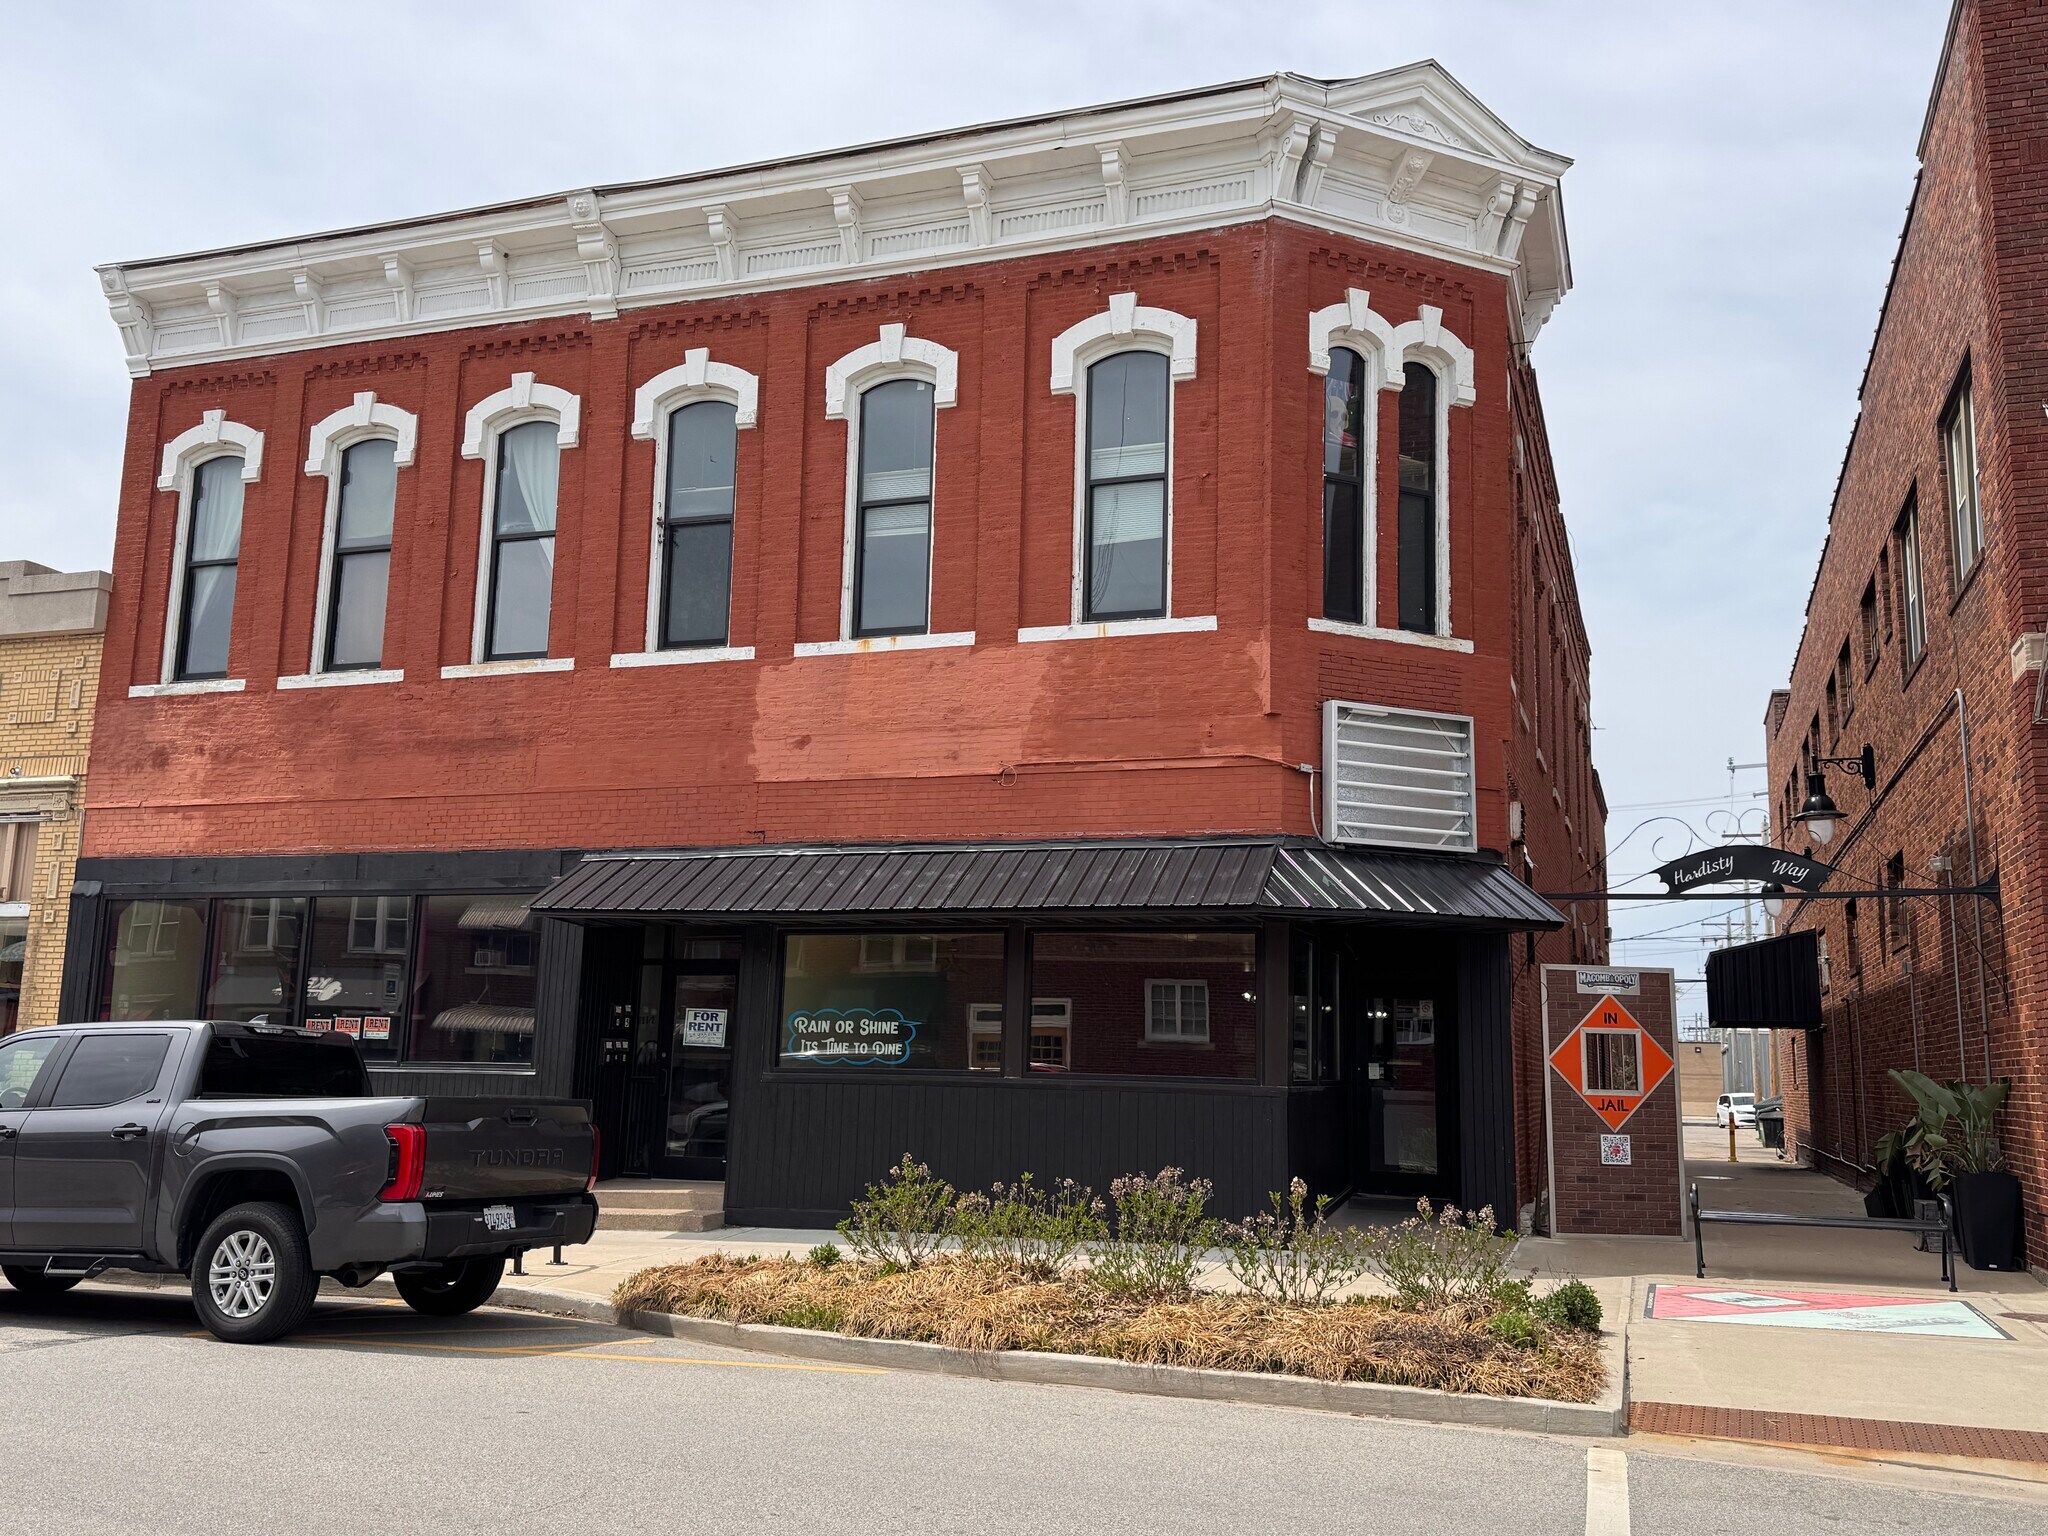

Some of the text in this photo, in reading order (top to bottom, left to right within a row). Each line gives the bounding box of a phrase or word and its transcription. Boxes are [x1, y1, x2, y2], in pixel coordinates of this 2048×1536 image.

[1674, 855, 1810, 885] Hardisty Way
[693, 1011, 719, 1022] FOR
[1603, 1012, 1618, 1025] IN
[311, 1021, 330, 1031] RENT
[340, 1019, 359, 1029] RENT
[369, 1019, 389, 1029] RENT
[688, 1022, 722, 1032] RENT
[1598, 1098, 1630, 1112] JAIL
[469, 1148, 564, 1167] TUNDRA
